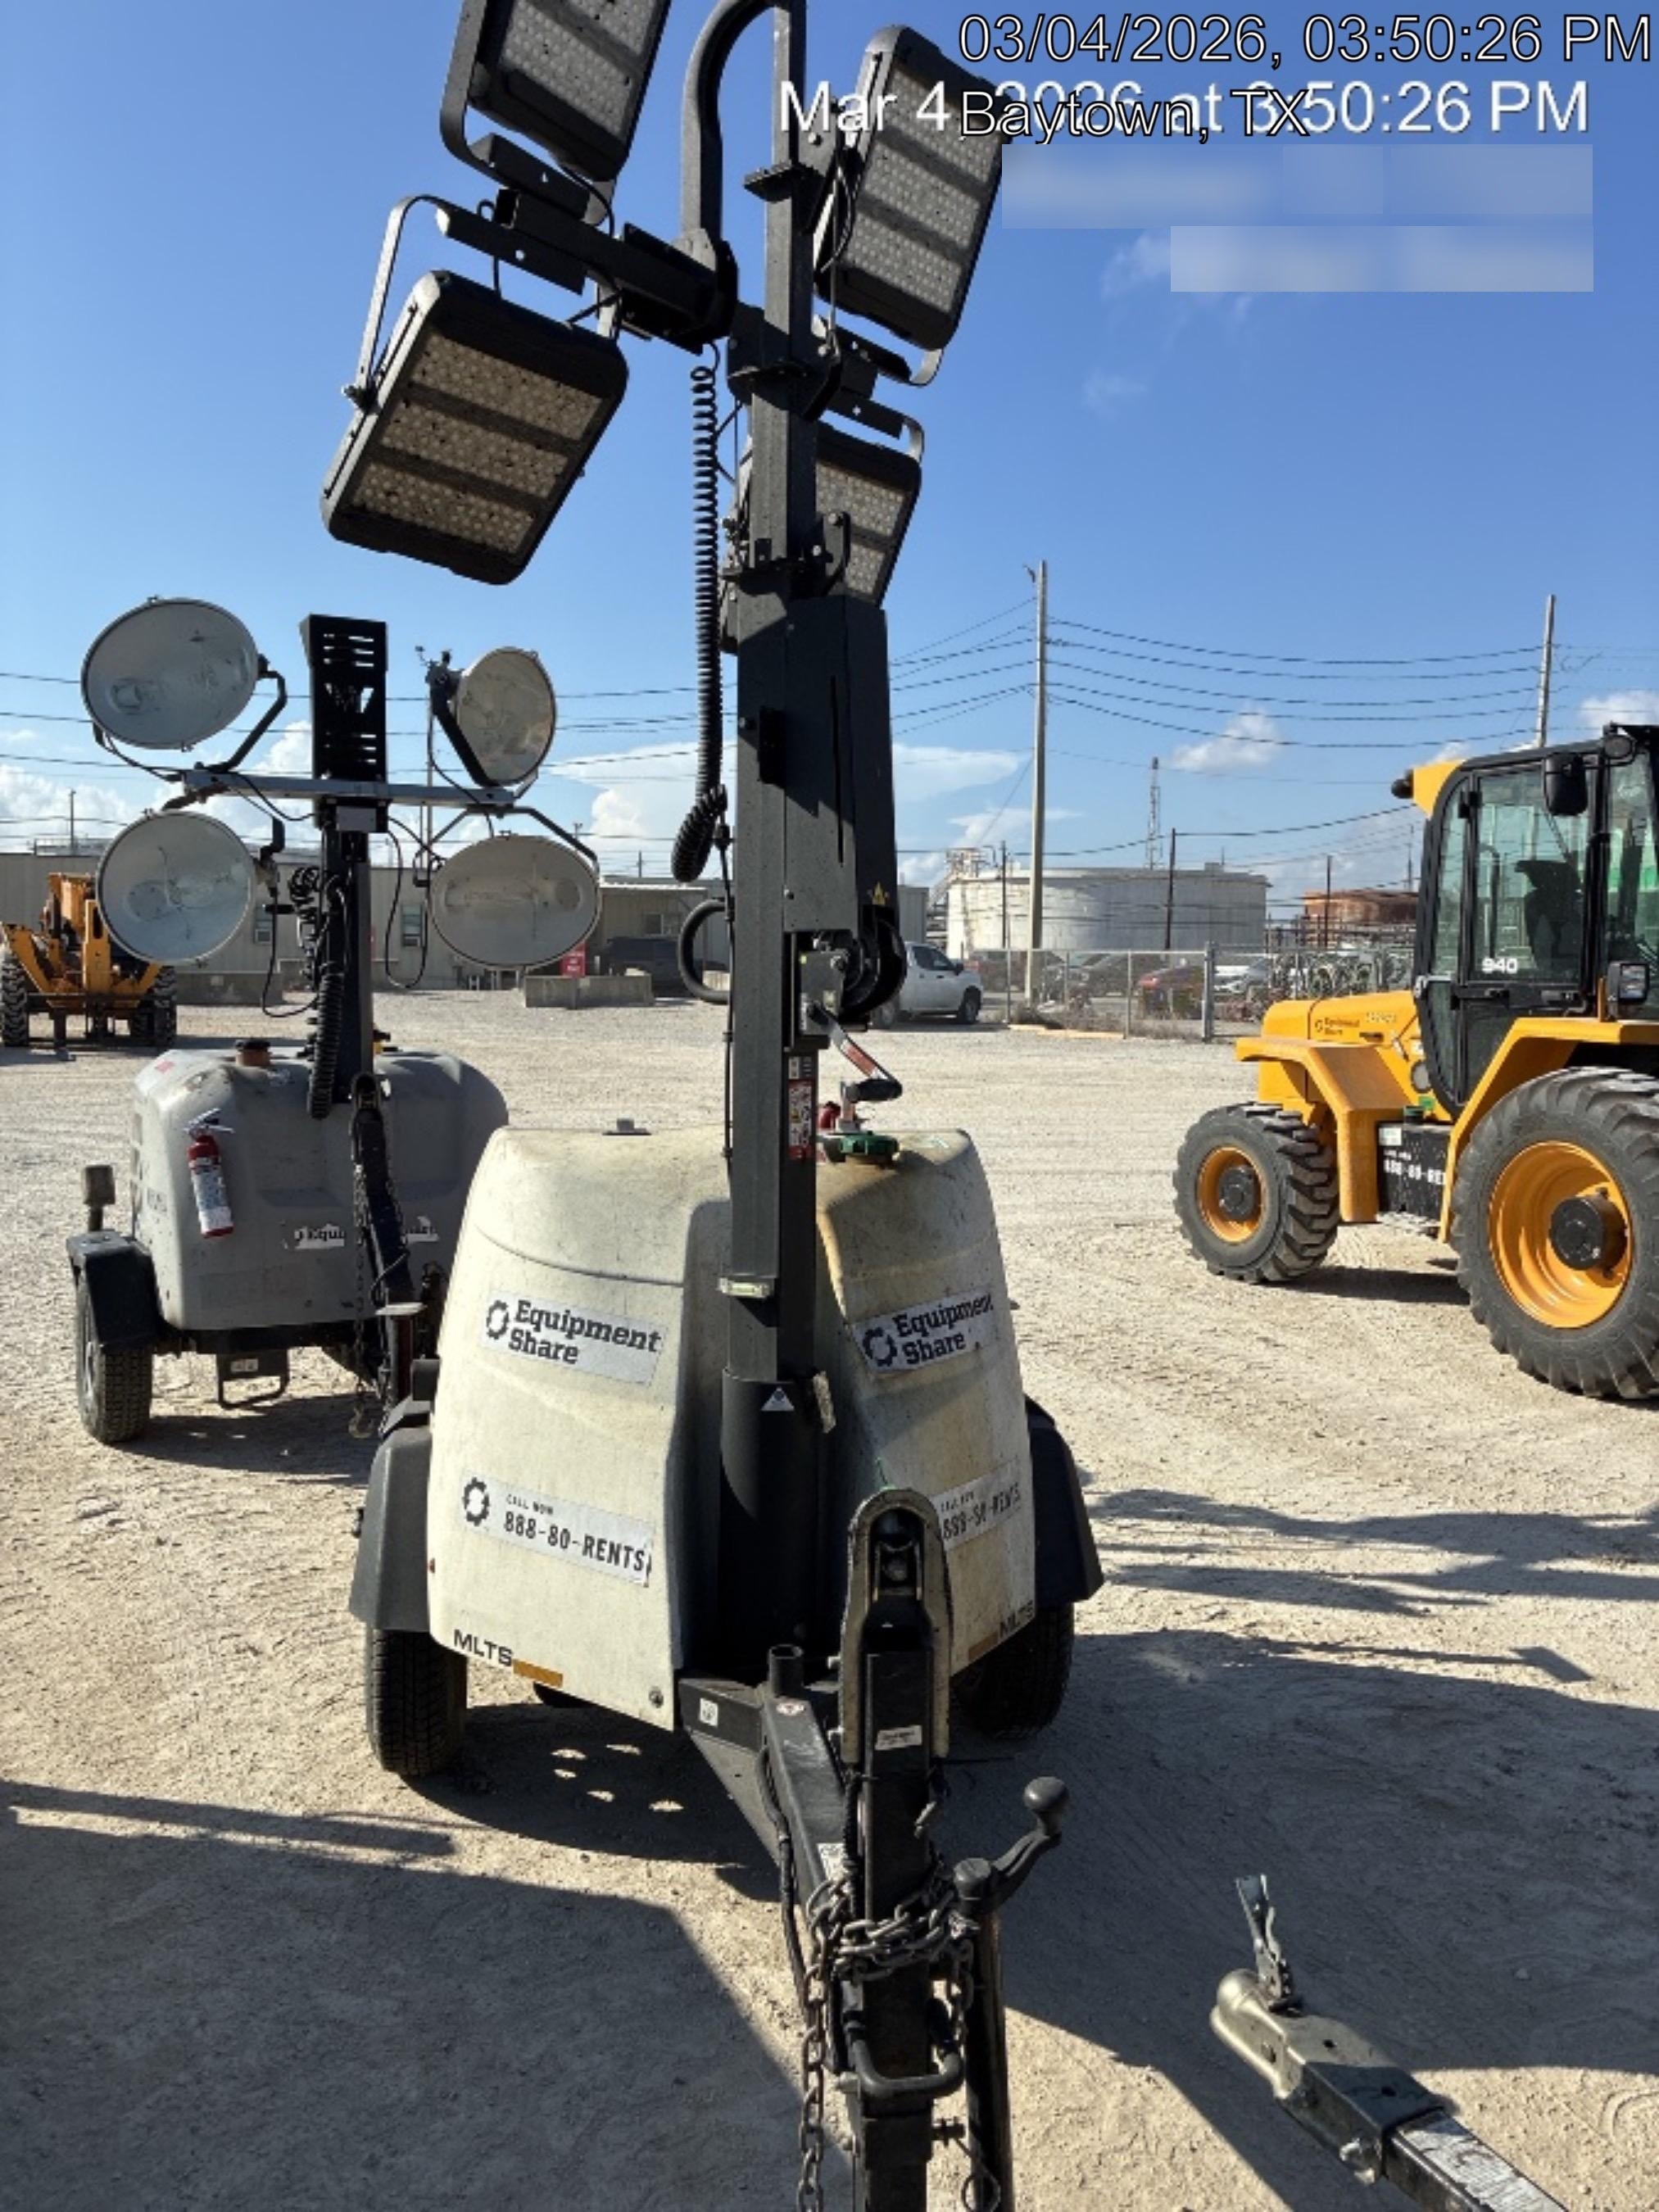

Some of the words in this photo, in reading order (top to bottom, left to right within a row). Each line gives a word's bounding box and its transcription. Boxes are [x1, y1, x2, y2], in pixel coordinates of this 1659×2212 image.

[1481, 957, 1517, 974] 940
[514, 1299, 661, 1353] Equipment
[508, 1328, 578, 1365] Share
[902, 1332, 967, 1365] Share
[504, 1511, 646, 1571] 888-80-RENTS
